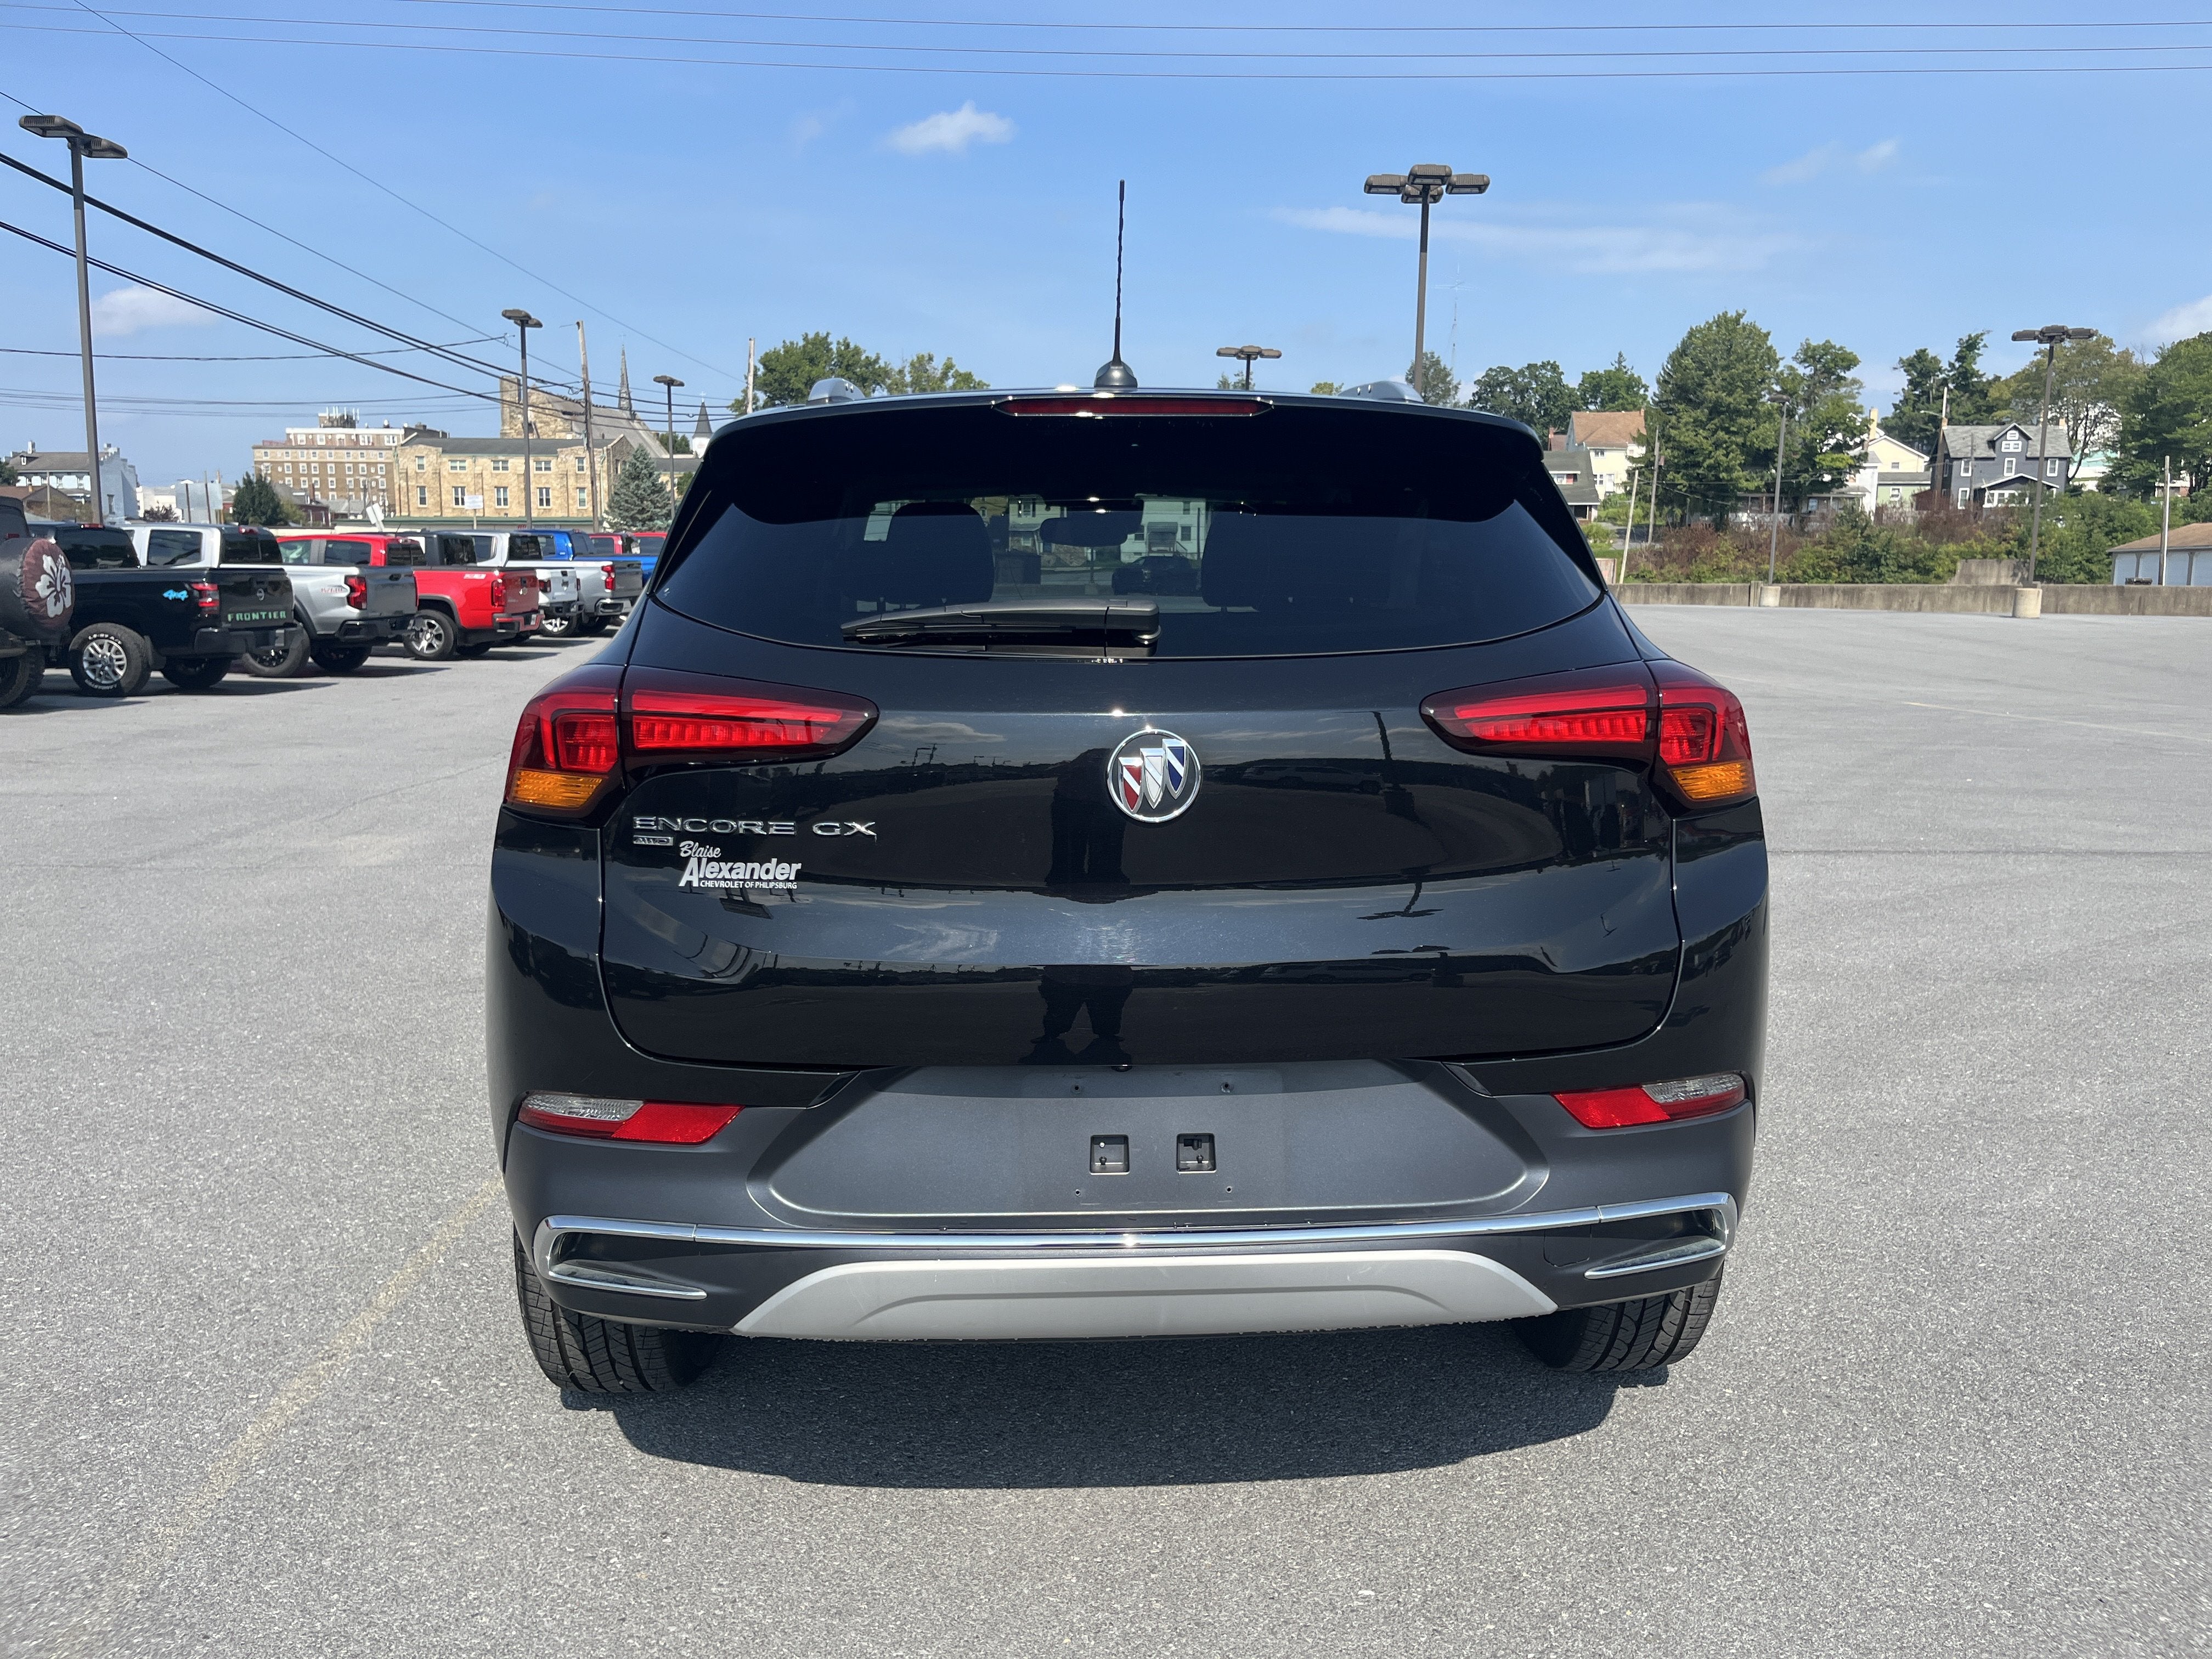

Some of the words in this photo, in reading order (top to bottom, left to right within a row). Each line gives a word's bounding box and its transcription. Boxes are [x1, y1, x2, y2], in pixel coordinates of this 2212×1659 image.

[228, 611, 286, 622] FRONTIER
[633, 816, 796, 834] ENCORE
[812, 822, 877, 836] GX
[635, 837, 669, 845] AWD
[679, 840, 721, 857] Blaise
[679, 857, 801, 887] Alexander
[700, 880, 743, 888] CHEVROLET
[755, 881, 798, 889] PHILIPSBURG
